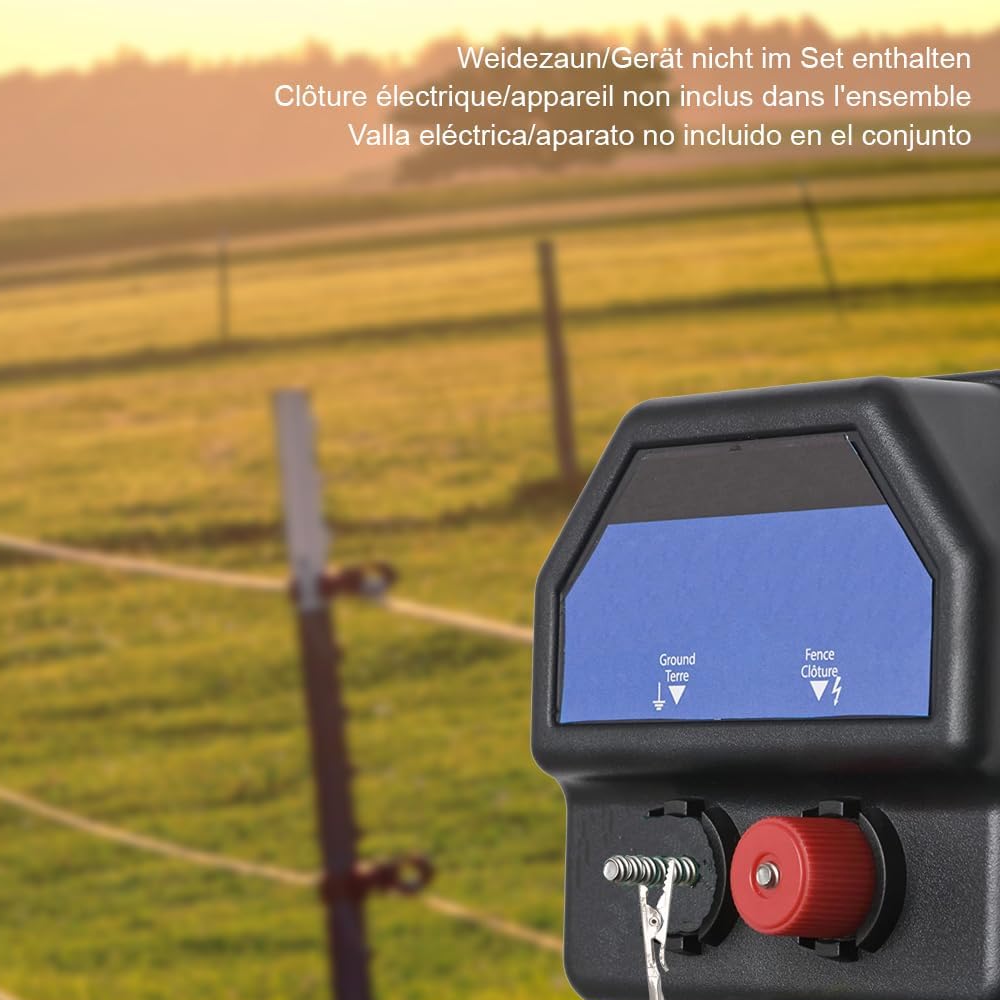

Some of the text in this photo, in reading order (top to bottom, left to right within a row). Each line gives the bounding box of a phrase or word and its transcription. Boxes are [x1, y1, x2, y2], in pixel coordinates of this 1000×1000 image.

[659, 652, 696, 667] Ground
[805, 648, 835, 661] Fence
[665, 669, 690, 683] Terre
[801, 664, 838, 679] Clôture
